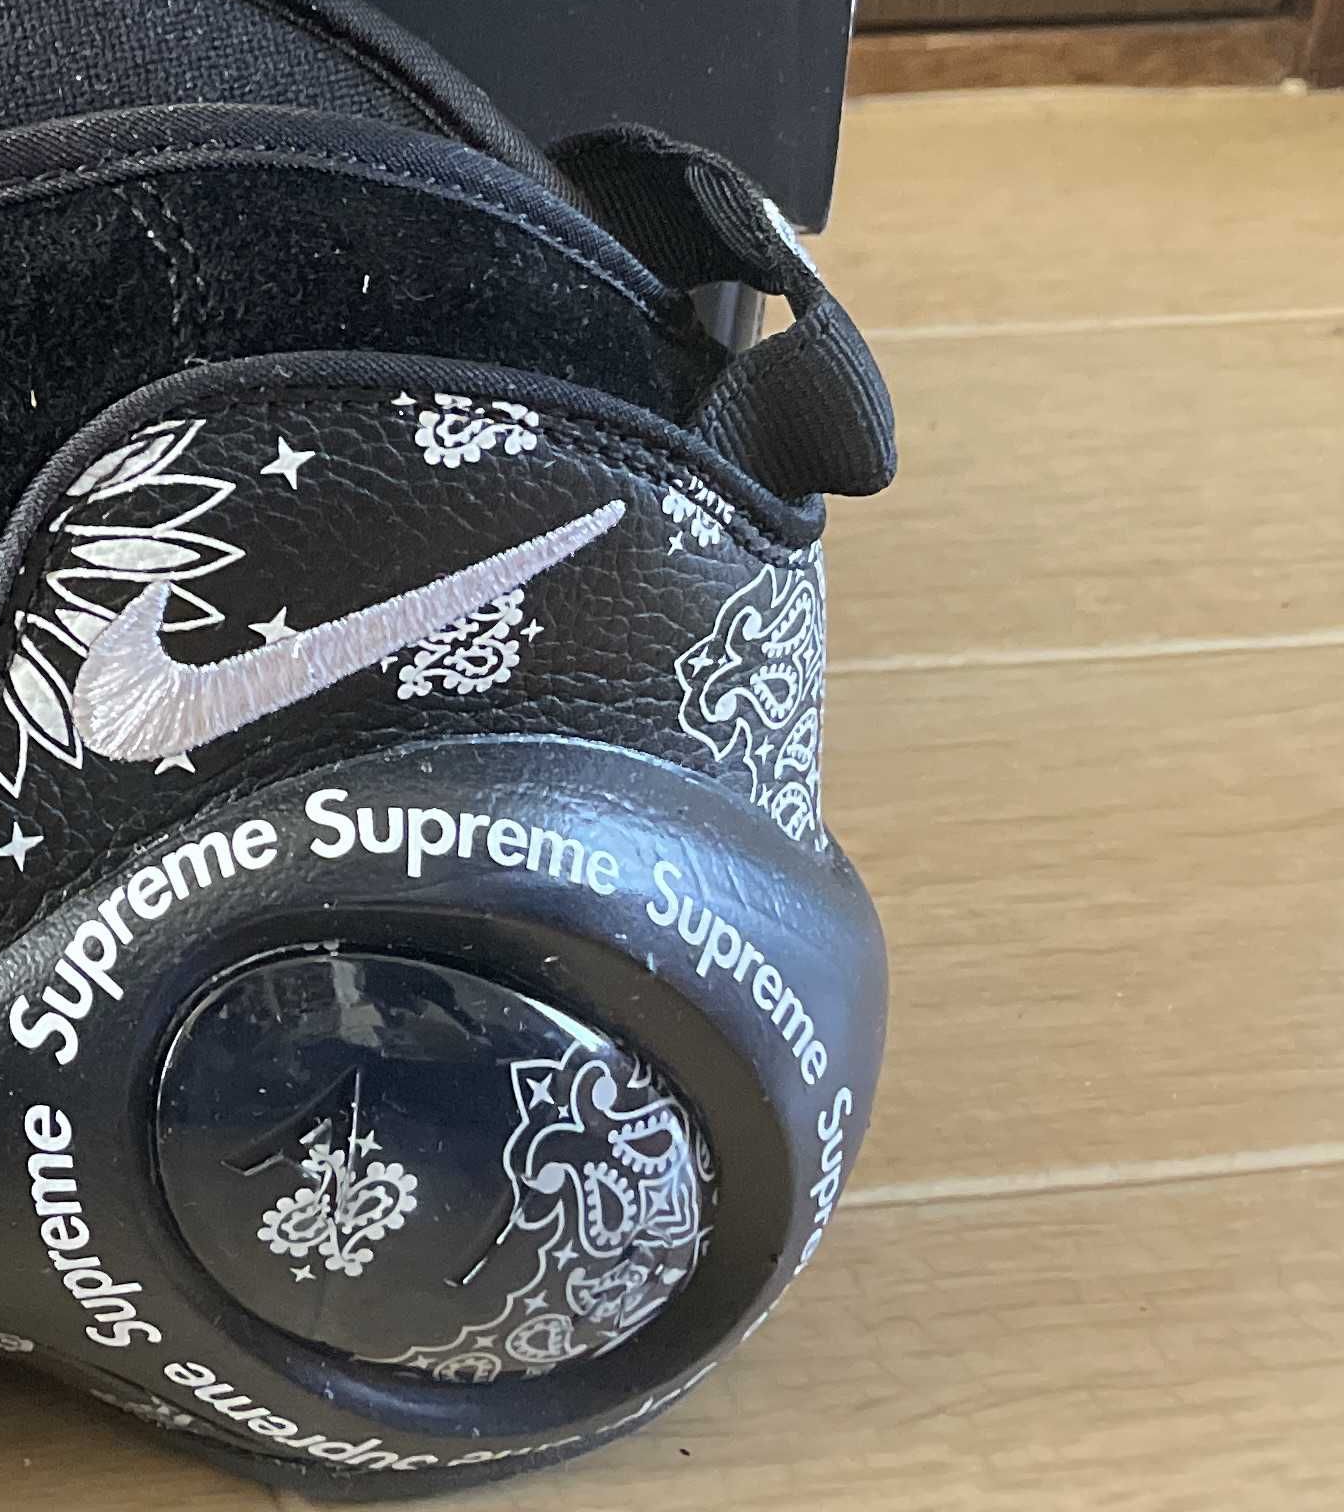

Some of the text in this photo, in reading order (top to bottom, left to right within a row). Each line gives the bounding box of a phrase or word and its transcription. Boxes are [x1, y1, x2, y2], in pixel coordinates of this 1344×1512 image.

[10, 818, 278, 1065] Supreme
[305, 788, 621, 897] Supreme
[645, 859, 829, 1085] Supreme
[24, 1104, 162, 1347] Supreme
[794, 1086, 853, 1275] Supr
